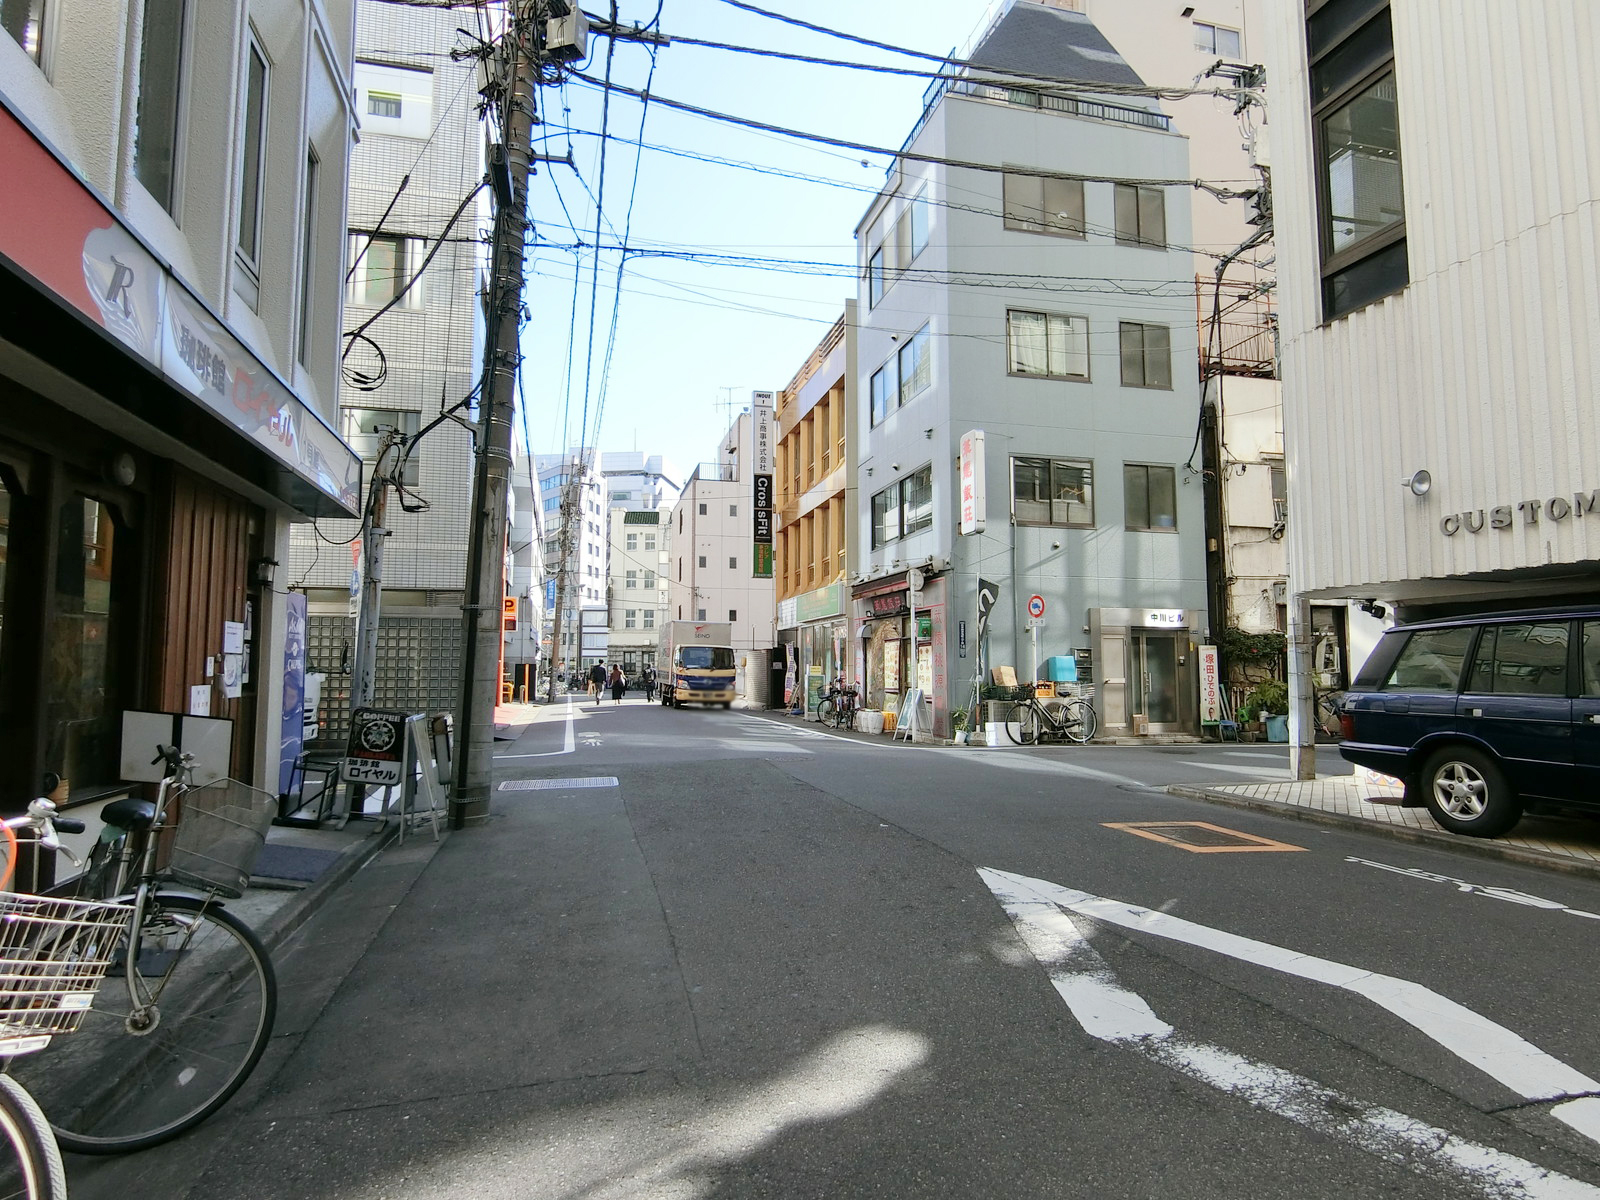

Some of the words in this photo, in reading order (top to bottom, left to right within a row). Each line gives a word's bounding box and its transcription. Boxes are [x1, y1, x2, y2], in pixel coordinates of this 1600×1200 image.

[106, 255, 135, 319] R
[759, 410, 767, 471] 井上商事株式会社
[1439, 489, 1600, 537] CUSTOM
[1150, 613, 1184, 623] 中川ビル
[362, 712, 400, 722] COFFEE
[347, 758, 380, 768] 珈琲館
[349, 767, 396, 780] ロイヤル
